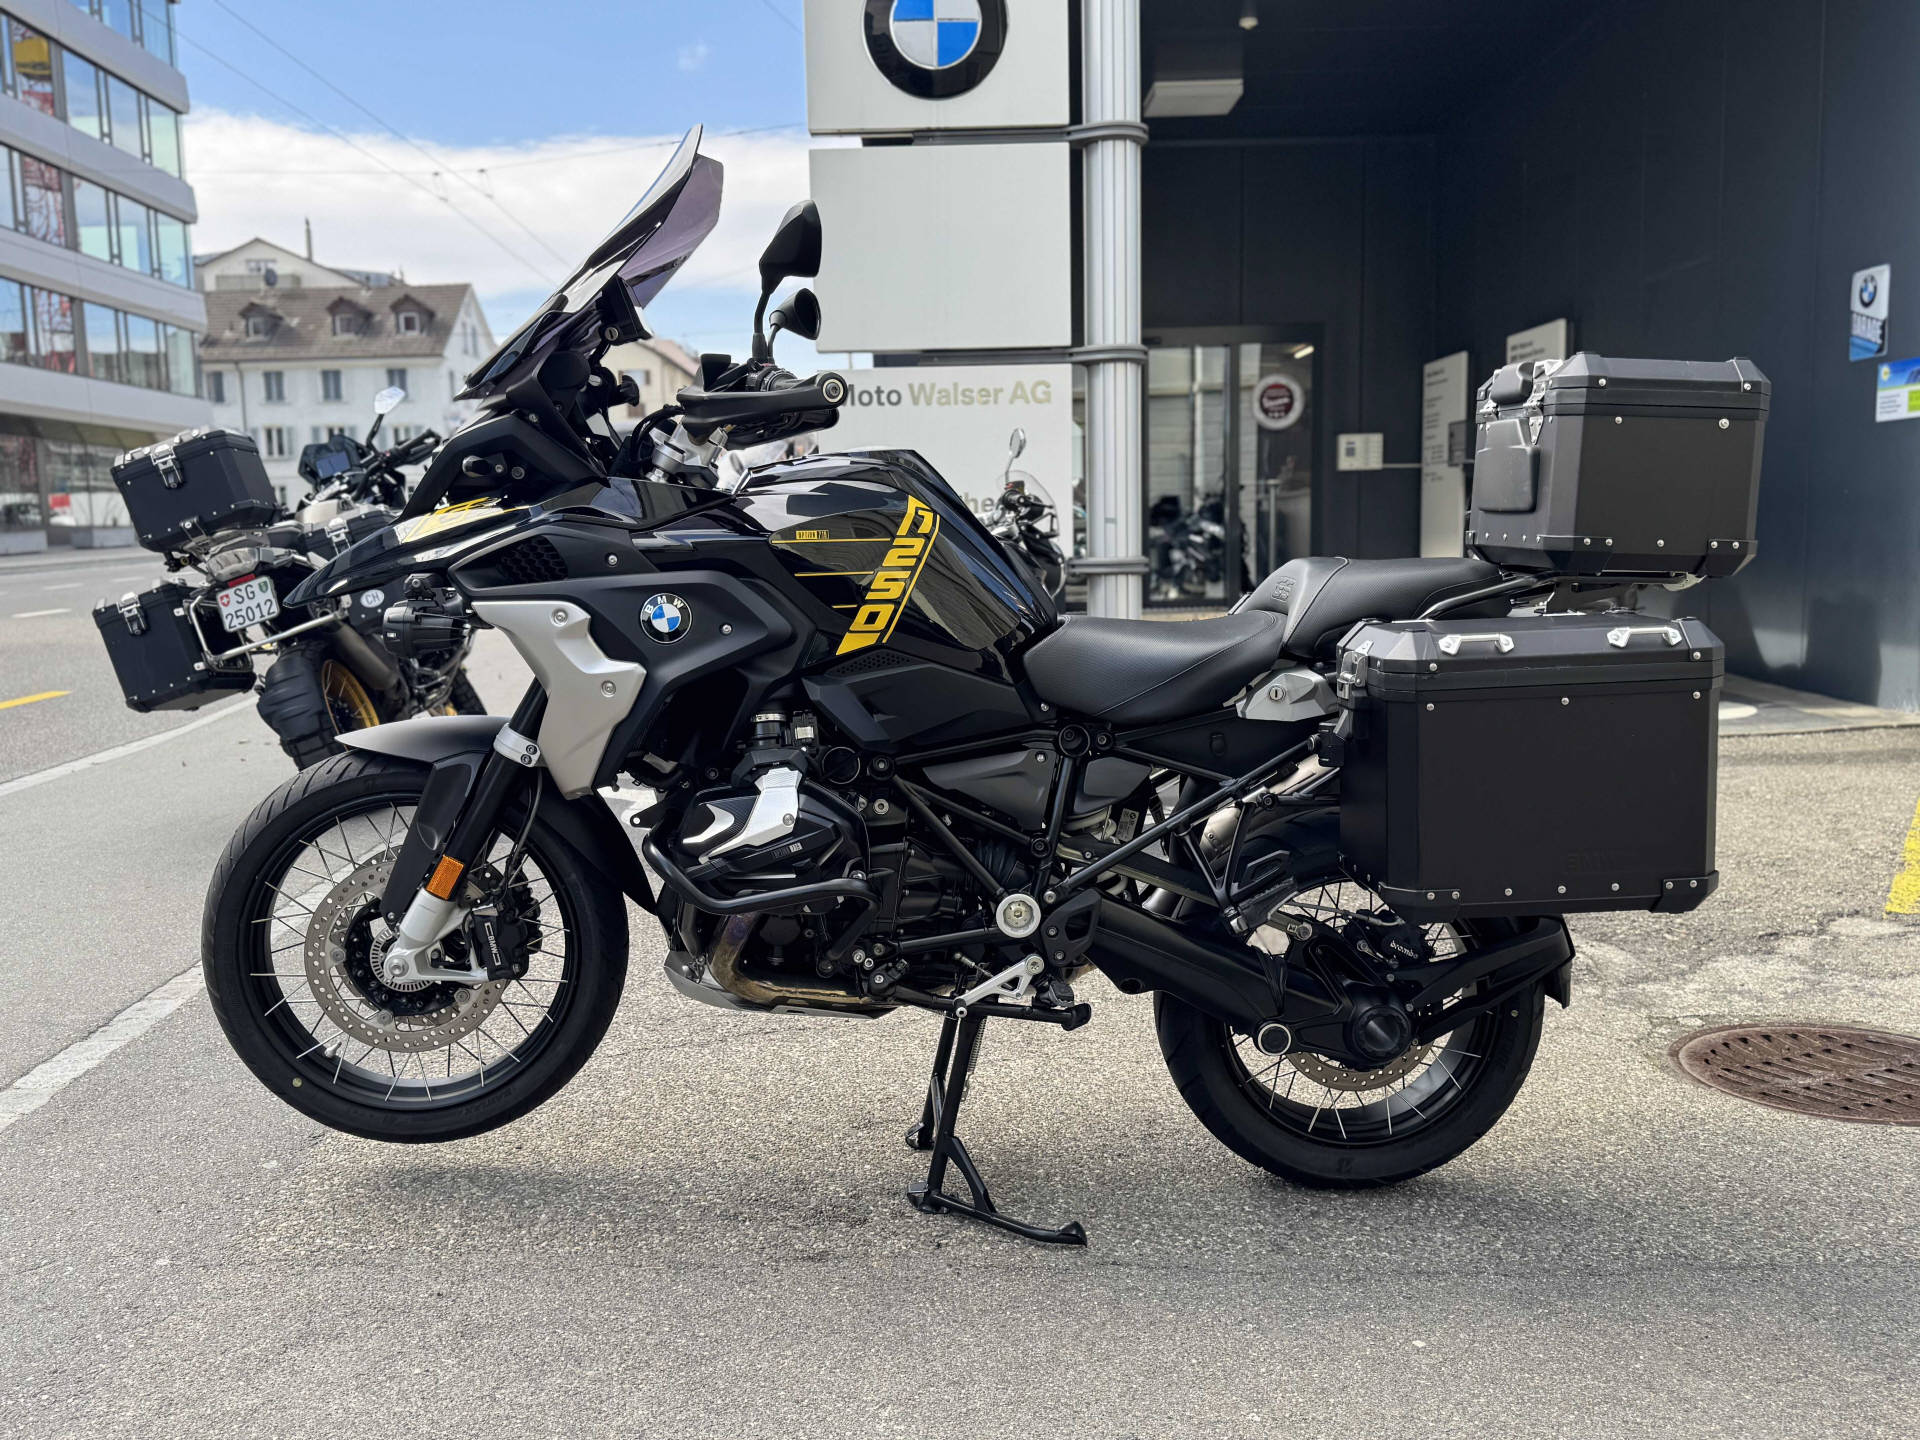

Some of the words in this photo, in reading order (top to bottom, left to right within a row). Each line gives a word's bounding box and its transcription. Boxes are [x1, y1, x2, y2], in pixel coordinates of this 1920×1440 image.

[908, 382, 1004, 406] Walser
[1009, 380, 1052, 405] AG
[233, 585, 256, 604] SG
[364, 593, 381, 605] CH
[225, 598, 276, 630] 25012
[644, 595, 685, 614] BMW
[487, 935, 499, 954] BMW
[1390, 940, 1419, 958] brembo
